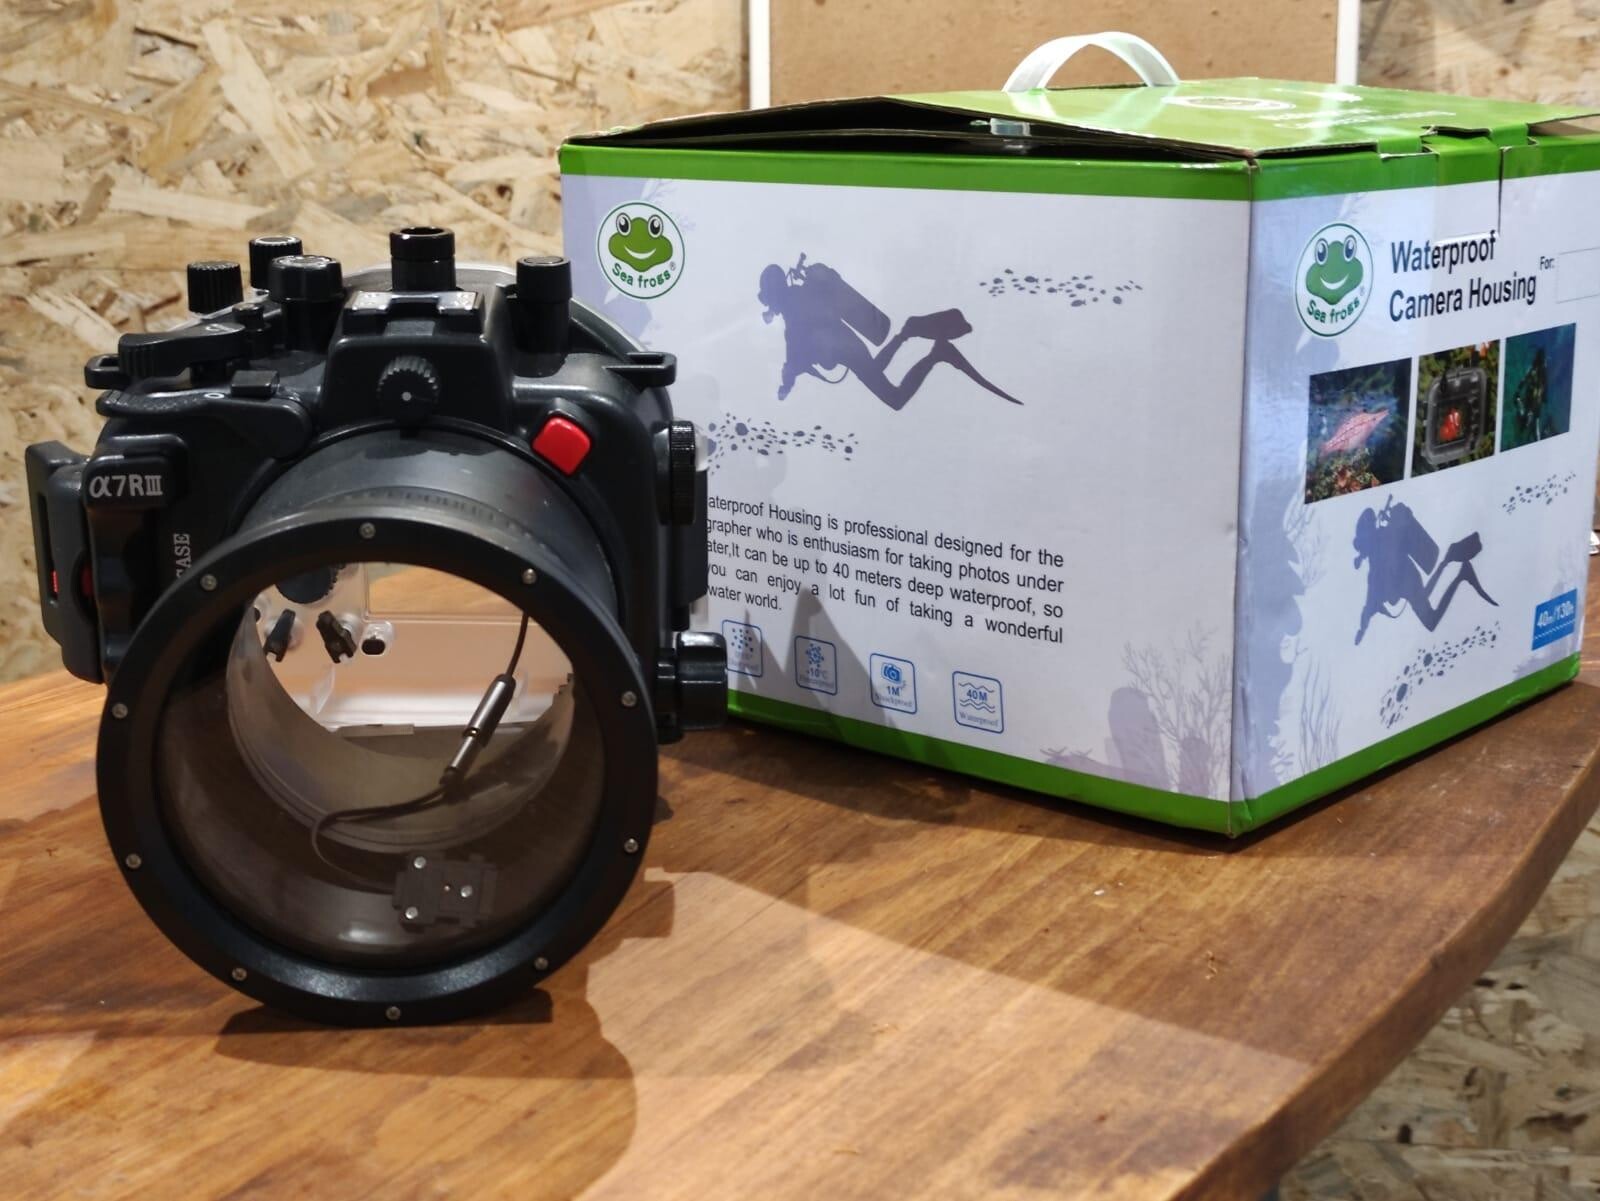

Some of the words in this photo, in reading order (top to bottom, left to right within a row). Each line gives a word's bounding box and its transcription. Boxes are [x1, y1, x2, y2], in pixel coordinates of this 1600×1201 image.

[612, 262, 634, 286] Sea
[638, 270, 672, 288] frogs
[1391, 229, 1497, 274] Waterproof
[1307, 299, 1327, 324] Sea
[1389, 289, 1463, 322] Camera
[1468, 271, 1537, 309] Housing
[706, 519, 752, 537] grapher
[756, 526, 783, 543] who
[787, 530, 798, 546] is
[803, 536, 880, 561] enthusiasm
[885, 547, 904, 565] for
[909, 553, 952, 578] taking
[960, 562, 1010, 584] photos
[1016, 574, 1064, 592] under
[708, 496, 764, 516] aterproof
[768, 503, 822, 531] Housing
[827, 513, 838, 530] is
[844, 520, 928, 546] professional
[934, 532, 1003, 558] designed
[1010, 543, 1032, 562] for
[1038, 548, 1064, 567] the
[707, 540, 740, 558] ater,It
[744, 547, 767, 562] can
[772, 550, 788, 567] be
[793, 557, 810, 573] up
[815, 559, 828, 575] to
[832, 562, 850, 579] 40
[855, 569, 902, 589] meters
[907, 576, 944, 600] deep
[950, 586, 1036, 616] waterproof,
[1043, 603, 1064, 618] so
[745, 592, 782, 610] world.
[735, 568, 758, 583] can
[767, 574, 802, 596] enjoy
[810, 583, 819, 595] a
[829, 583, 846, 601] lot
[855, 589, 876, 608] fun
[886, 597, 900, 612] of
[909, 601, 953, 627] taking
[964, 614, 973, 627] a
[984, 618, 1063, 643] wonderful
